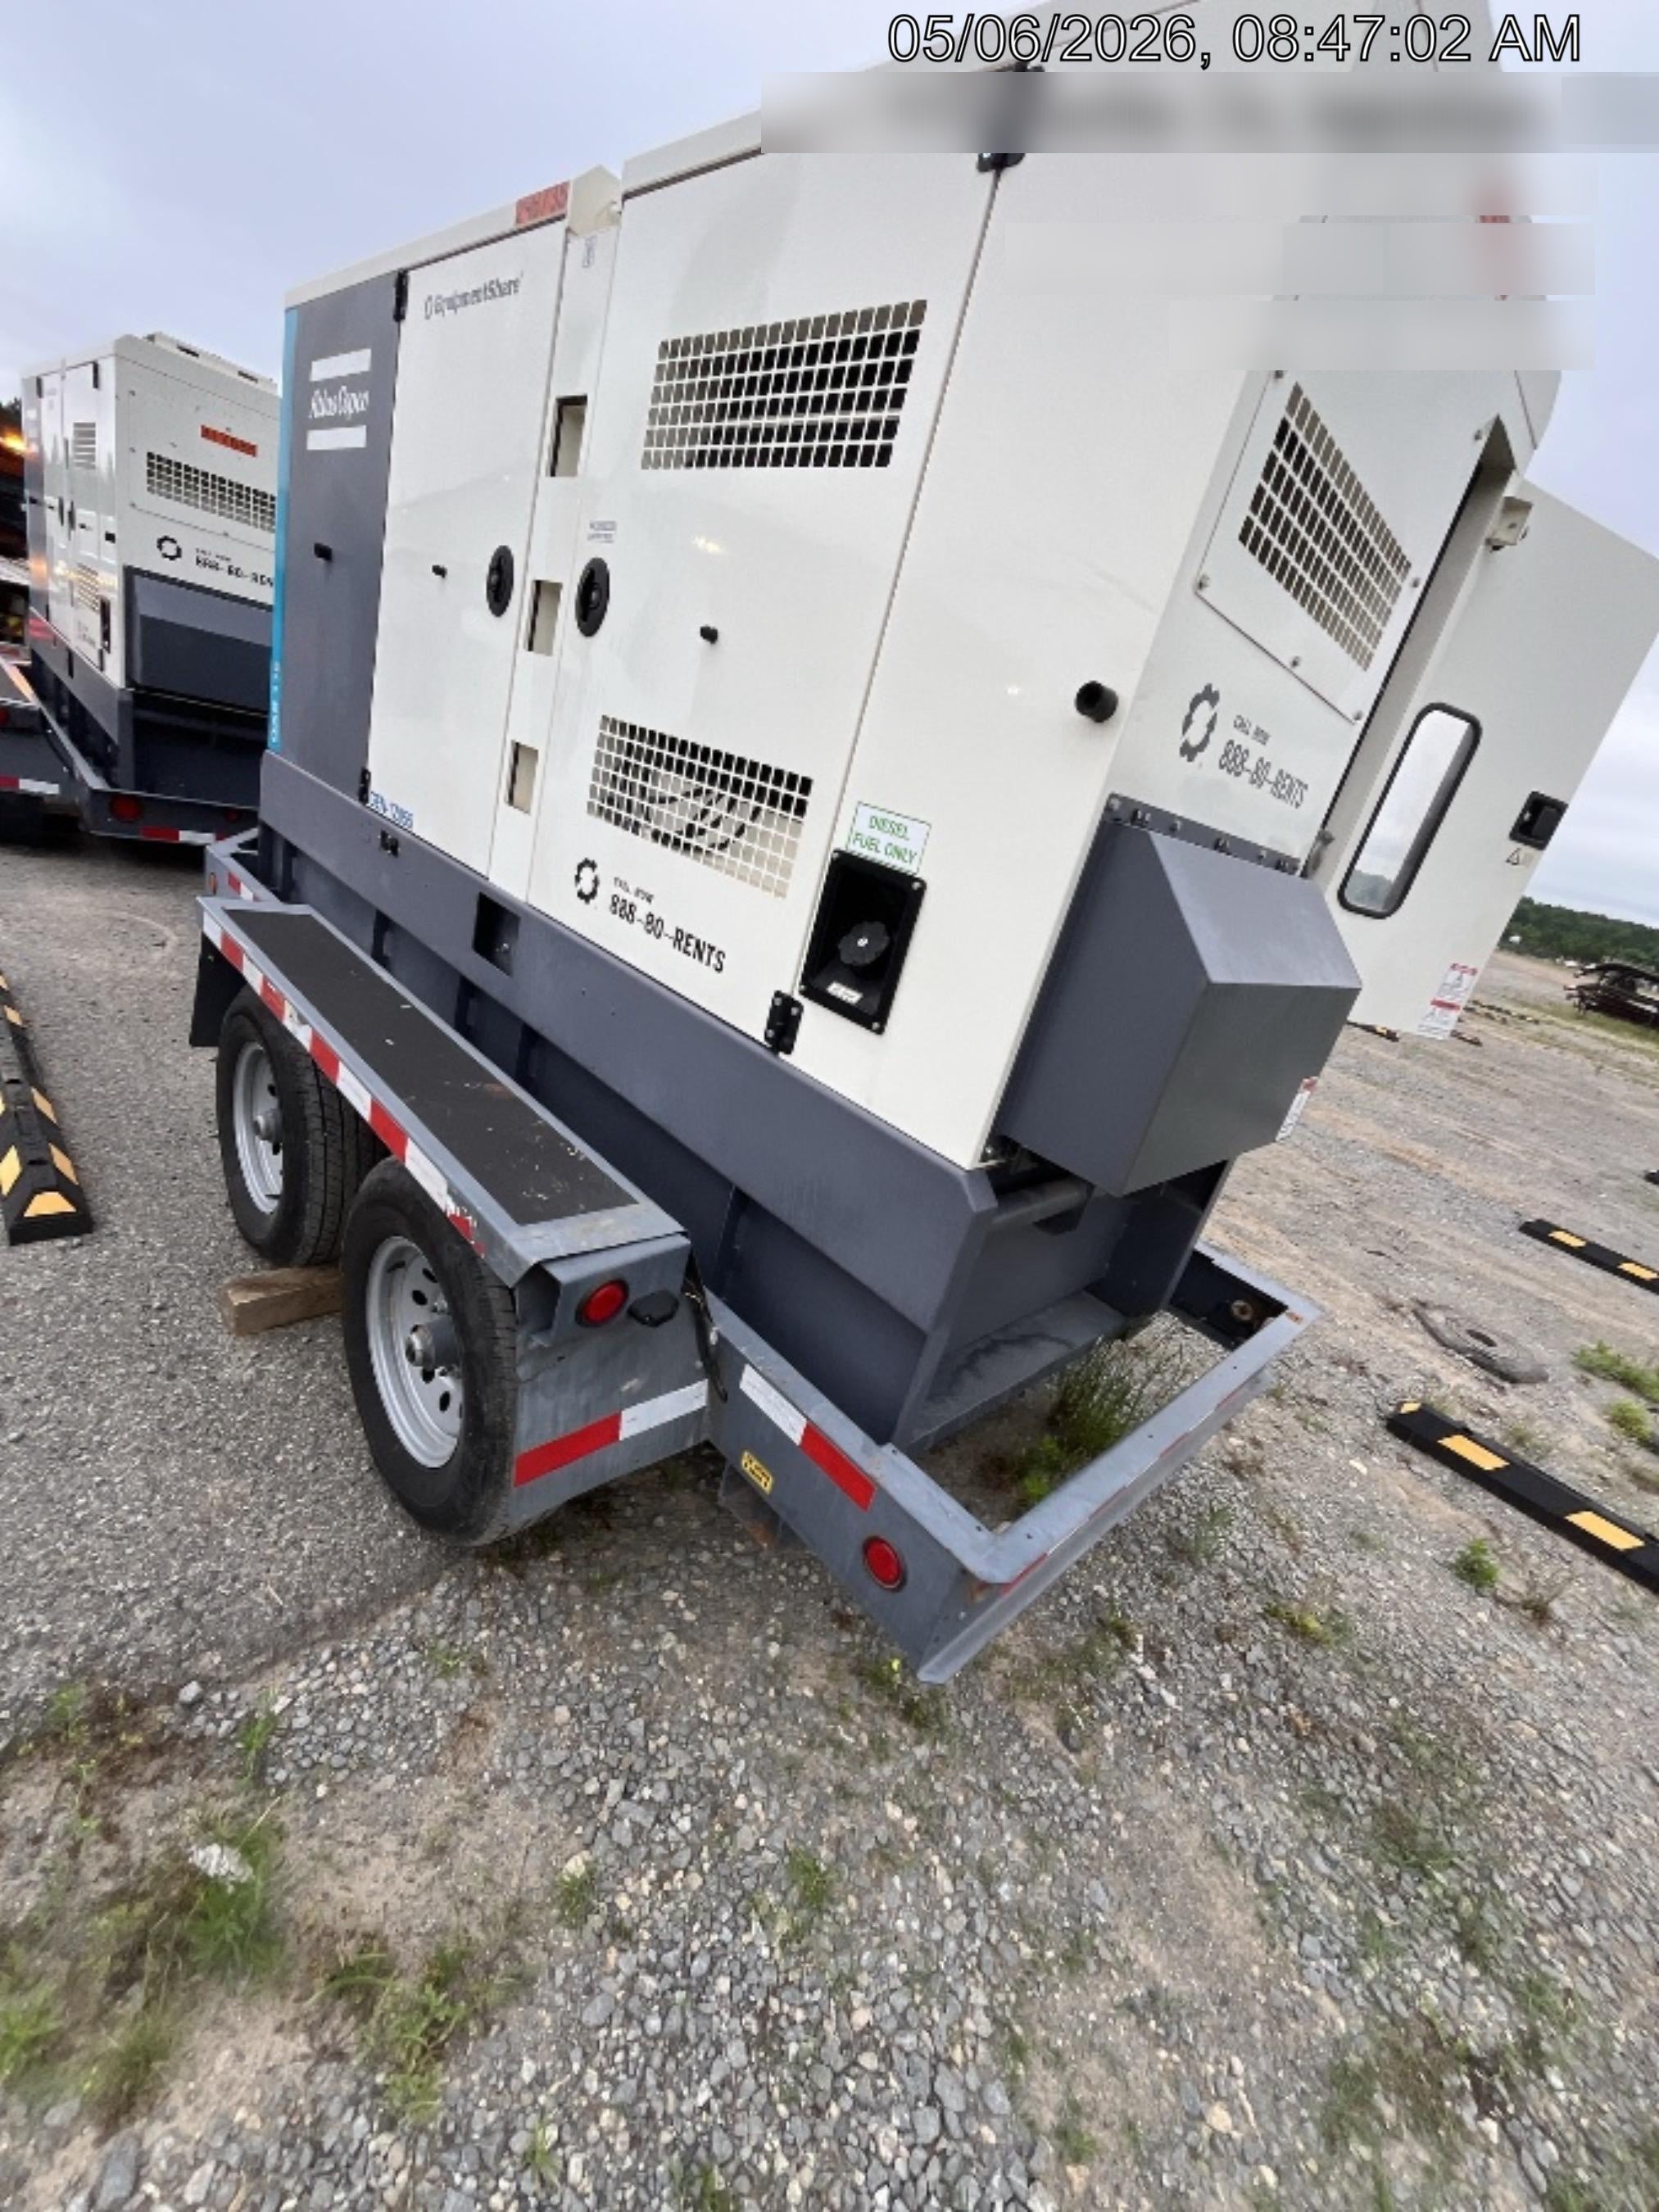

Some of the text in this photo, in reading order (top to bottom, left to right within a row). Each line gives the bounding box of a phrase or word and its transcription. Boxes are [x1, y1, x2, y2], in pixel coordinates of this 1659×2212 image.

[1218, 738, 1309, 809] 888-80-RENTS
[852, 832, 918, 865] FUEL ONLY
[869, 815, 909, 841] DIESEL
[609, 894, 726, 973] 888-80-RENTS
